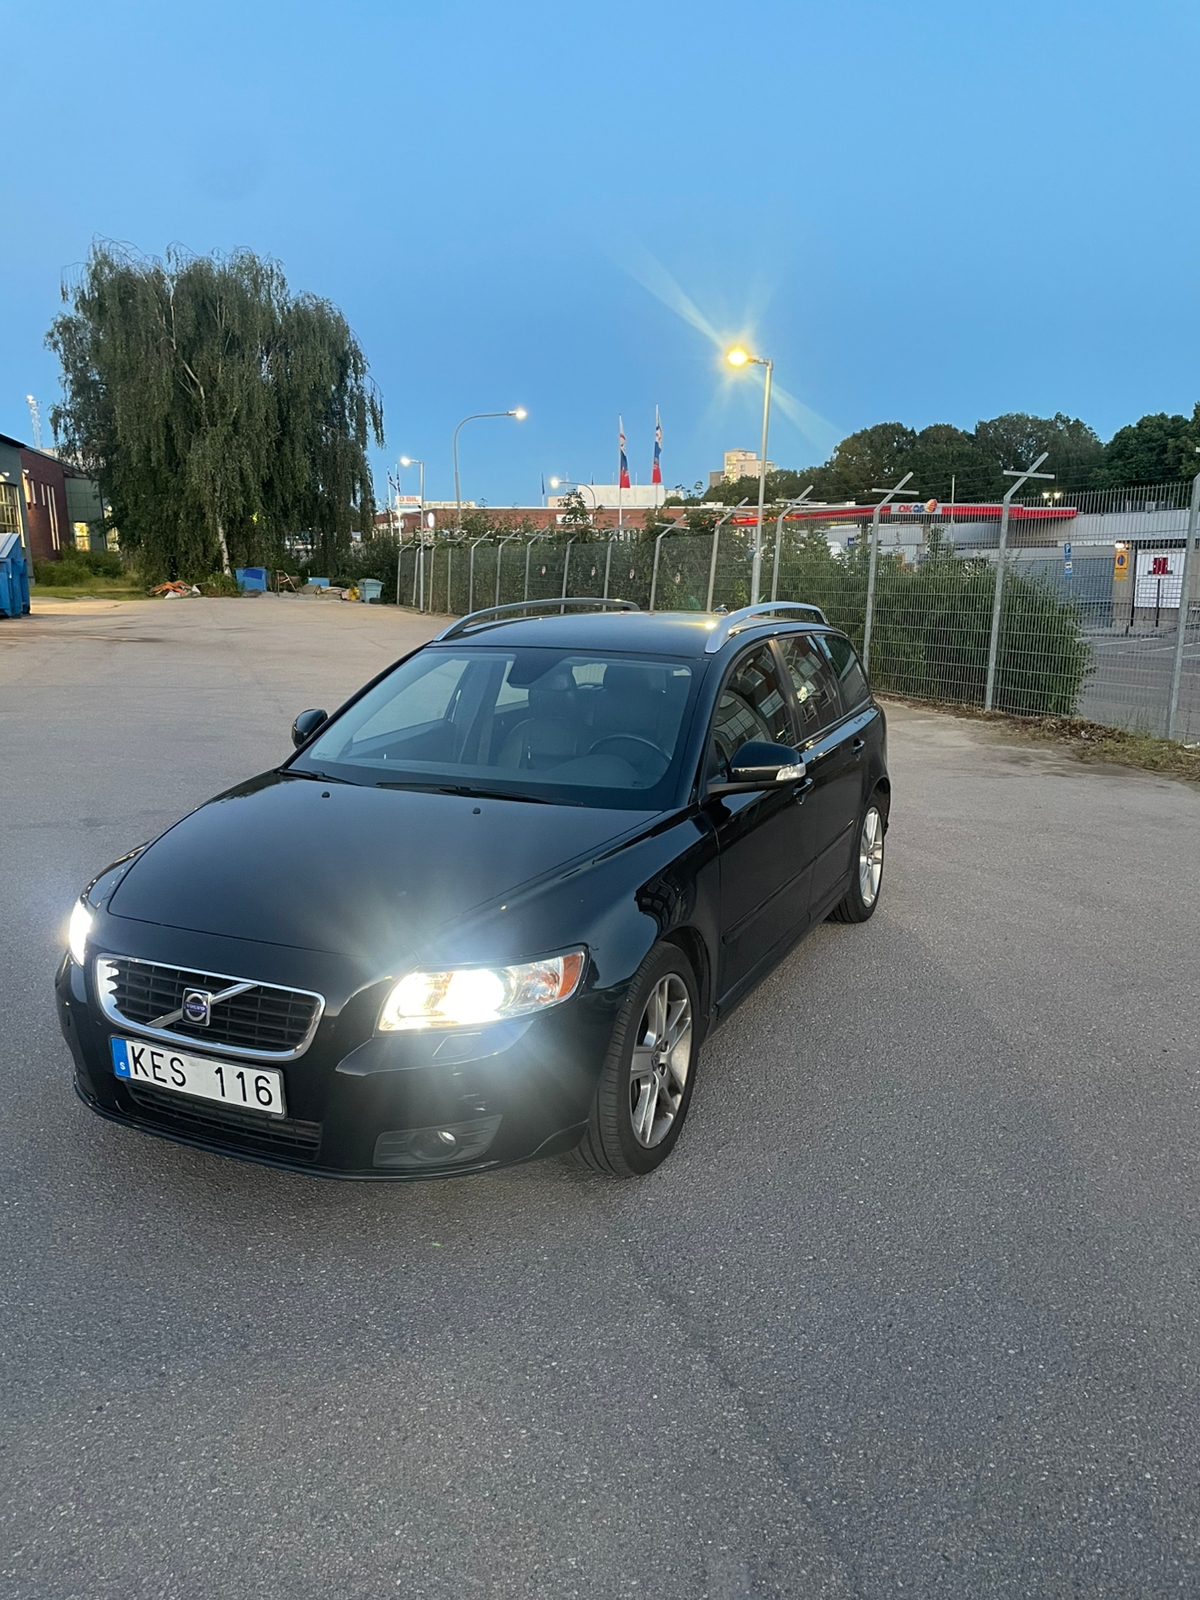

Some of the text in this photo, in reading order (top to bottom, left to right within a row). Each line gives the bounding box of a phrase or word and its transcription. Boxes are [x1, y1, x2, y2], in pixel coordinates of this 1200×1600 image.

[186, 1003, 206, 1011] VOLVO
[119, 1061, 126, 1071] S
[131, 1045, 273, 1106] KES 116
